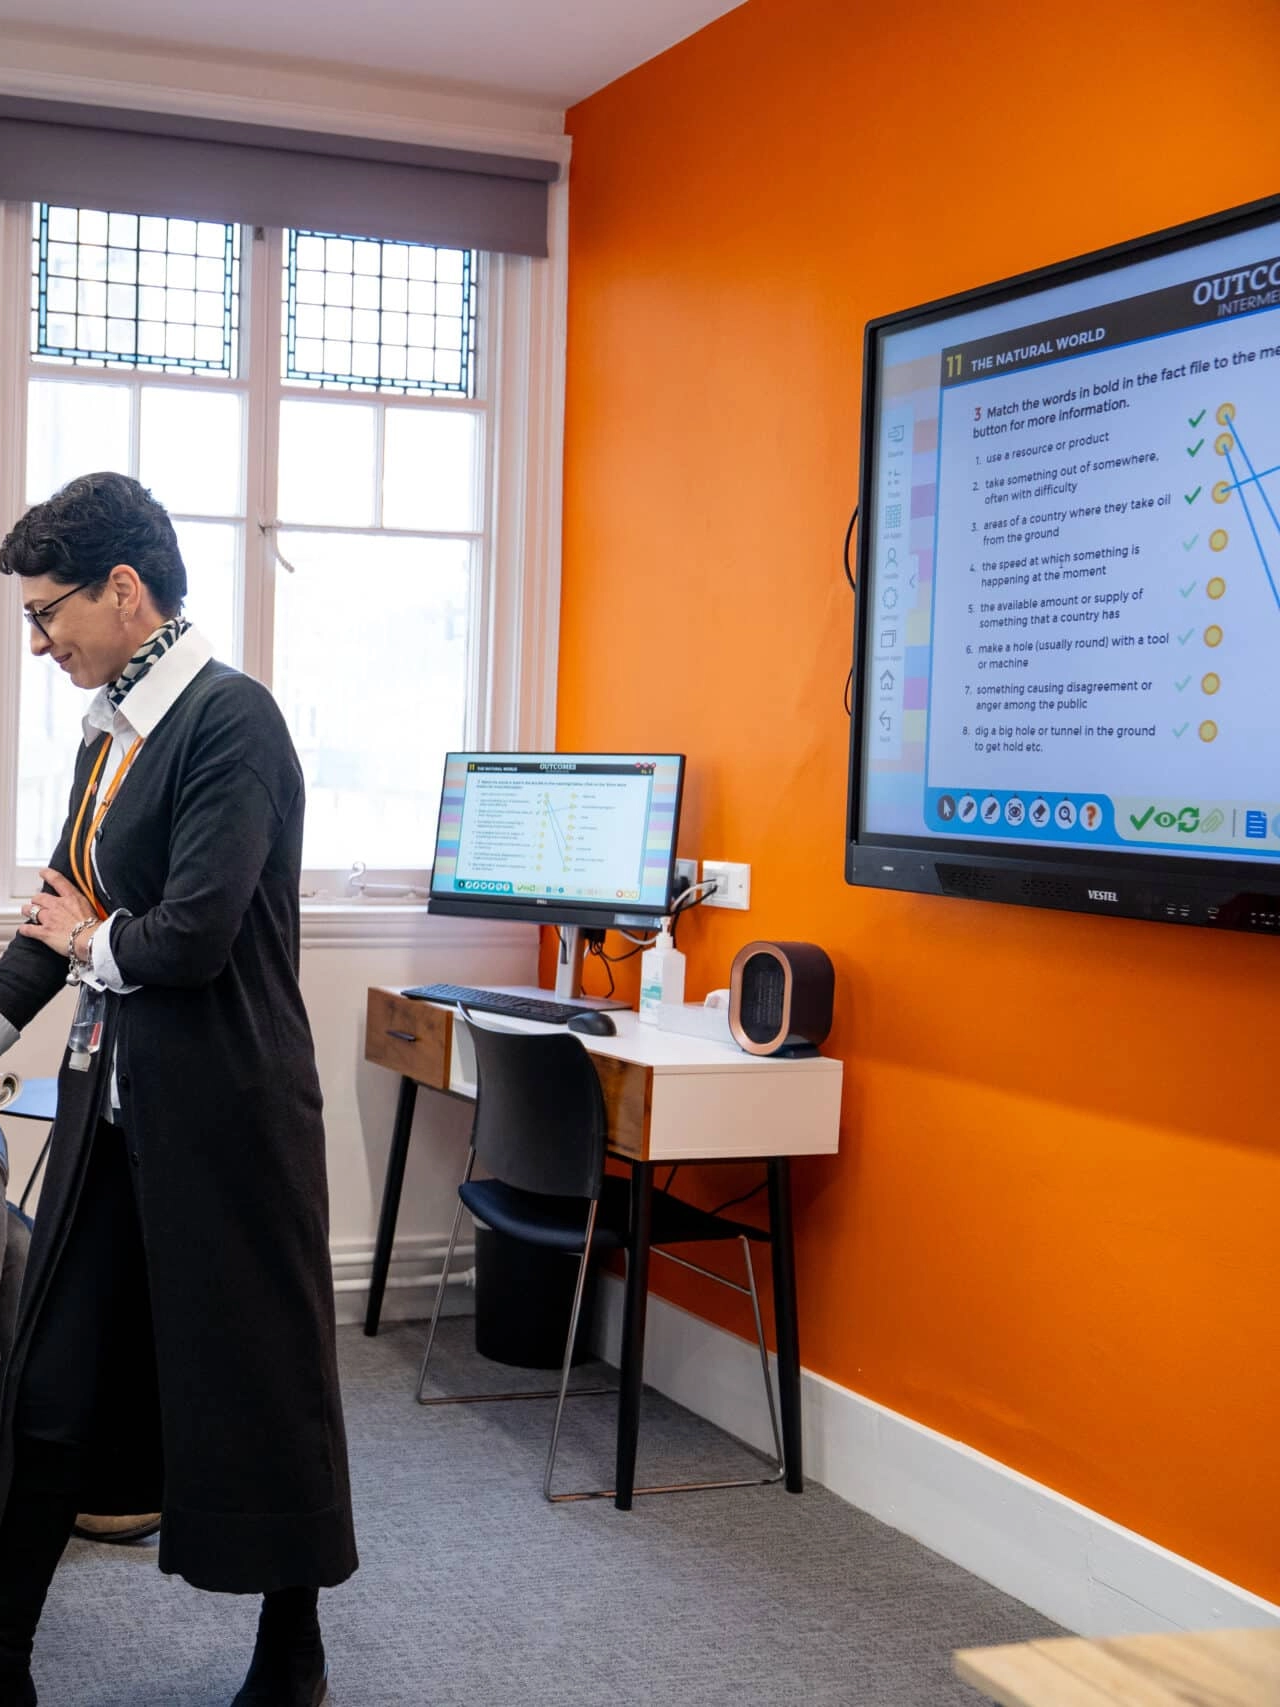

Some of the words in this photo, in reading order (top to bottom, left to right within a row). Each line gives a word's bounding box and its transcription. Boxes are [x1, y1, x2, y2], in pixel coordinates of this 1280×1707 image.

[947, 354, 962, 378] 11
[972, 356, 992, 372] THE
[996, 343, 1053, 365] NATURAL
[1056, 328, 1105, 349] WORLD
[974, 407, 982, 421] 3
[987, 404, 1019, 419] Match
[1022, 398, 1039, 411] the
[1042, 390, 1076, 405] words
[1080, 386, 1089, 398] in
[1093, 378, 1119, 396] bold
[1122, 377, 1133, 389] in
[1137, 372, 1157, 386] the
[1161, 365, 1186, 381] fact
[1190, 360, 1210, 375] file
[1214, 357, 1228, 369] to
[1232, 351, 1256, 365] the
[973, 423, 1007, 438] button
[1010, 420, 1025, 432] for
[1028, 414, 1056, 428] more
[1059, 399, 1130, 421] information.
[987, 453, 1002, 463] use
[1004, 452, 1010, 460] a
[1012, 443, 1053, 459] resource
[1056, 441, 1065, 450] or
[1069, 432, 1109, 450] product
[985, 478, 1004, 489] take
[1008, 467, 1058, 485] something
[1060, 466, 1077, 477] out
[1080, 462, 1091, 473] of
[985, 492, 1008, 505] often
[1012, 489, 1031, 500] with
[1034, 482, 1077, 498] difficulty
[984, 520, 1007, 530] areas
[1010, 515, 1020, 526] of
[1030, 511, 1067, 524] country
[1070, 505, 1101, 519] where
[1104, 501, 1127, 514] they
[1131, 498, 1154, 510] take
[1158, 495, 1171, 506] oil
[984, 534, 1004, 546] from
[1007, 532, 1022, 542] the
[1024, 527, 1059, 543] ground
[983, 561, 996, 571] the
[999, 559, 1026, 571] speed
[1029, 557, 1039, 565] at
[1041, 553, 1070, 564] which
[1073, 546, 1128, 561] something
[1132, 545, 1140, 554] is
[981, 574, 1029, 588] happening
[1032, 572, 1041, 582] at
[1044, 571, 1060, 580] the
[1063, 566, 1106, 579] moment
[981, 603, 995, 612] the
[997, 598, 1037, 611] available
[1040, 596, 1078, 607] amount
[1081, 595, 1091, 604] or
[1094, 591, 1128, 604] supply
[1132, 589, 1144, 599] of
[980, 616, 1027, 629] something
[1031, 614, 1050, 624] that
[1052, 615, 1057, 623] a
[1061, 610, 1099, 623] country
[1103, 609, 1120, 619] has
[979, 644, 1003, 654] make
[1013, 641, 1033, 652] hole
[1036, 639, 1071, 652] (usually
[1075, 636, 1108, 648] round)
[1112, 636, 1134, 646] with
[1138, 636, 1143, 644] a
[1147, 633, 1168, 644] tool
[978, 660, 987, 668] or
[990, 658, 1028, 668] machine
[977, 682, 1024, 696] something
[1027, 682, 1063, 695] causing
[1067, 681, 1137, 694] disagreement
[1141, 681, 1152, 690] or
[976, 700, 1001, 711] anger
[1004, 700, 1036, 711] among
[1039, 699, 1054, 709] the
[1057, 699, 1087, 710] public
[975, 726, 989, 737] dig
[991, 727, 996, 735] a
[999, 726, 1012, 737] big
[1016, 726, 1035, 736] hole
[1038, 727, 1048, 736] or
[1051, 726, 1081, 736] tunnel
[1085, 726, 1093, 736] in
[1097, 726, 1113, 736] the
[1117, 726, 1155, 738] ground
[975, 742, 984, 751] to
[986, 743, 1000, 753] get
[1003, 742, 1023, 751] hold
[1026, 743, 1043, 752] etc.
[1088, 889, 1119, 902] VESTEL
